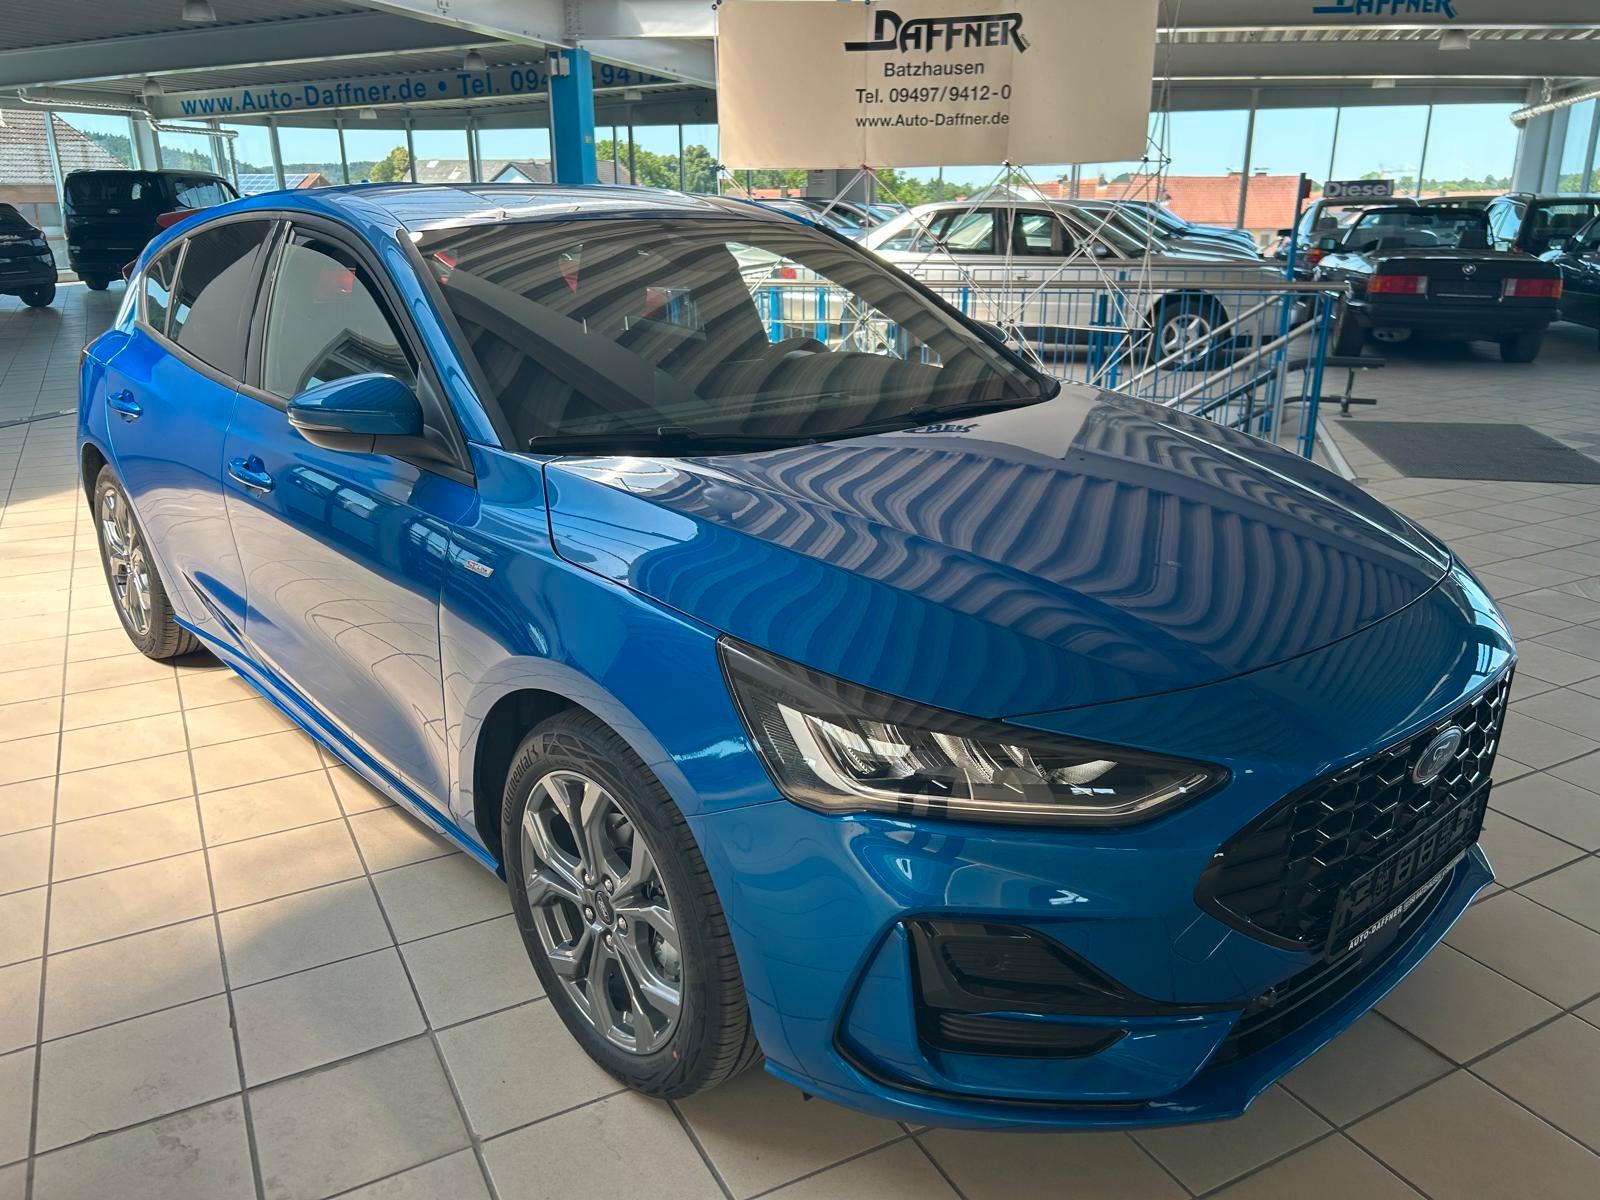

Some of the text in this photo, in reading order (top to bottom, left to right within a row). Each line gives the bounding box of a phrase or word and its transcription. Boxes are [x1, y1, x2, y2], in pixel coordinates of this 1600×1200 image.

[844, 10, 1028, 53] DAFFNER
[884, 61, 985, 77] Batzhausen
[181, 78, 427, 115] www.Auto-Daffner.de
[457, 72, 499, 96] Tel.
[856, 84, 1012, 103] Tel. 09497/9412-0
[856, 112, 1009, 127] www.Auto-Daffner.de
[1326, 181, 1392, 197] Diesel
[1348, 905, 1403, 950] AUTO-DAFFNER
